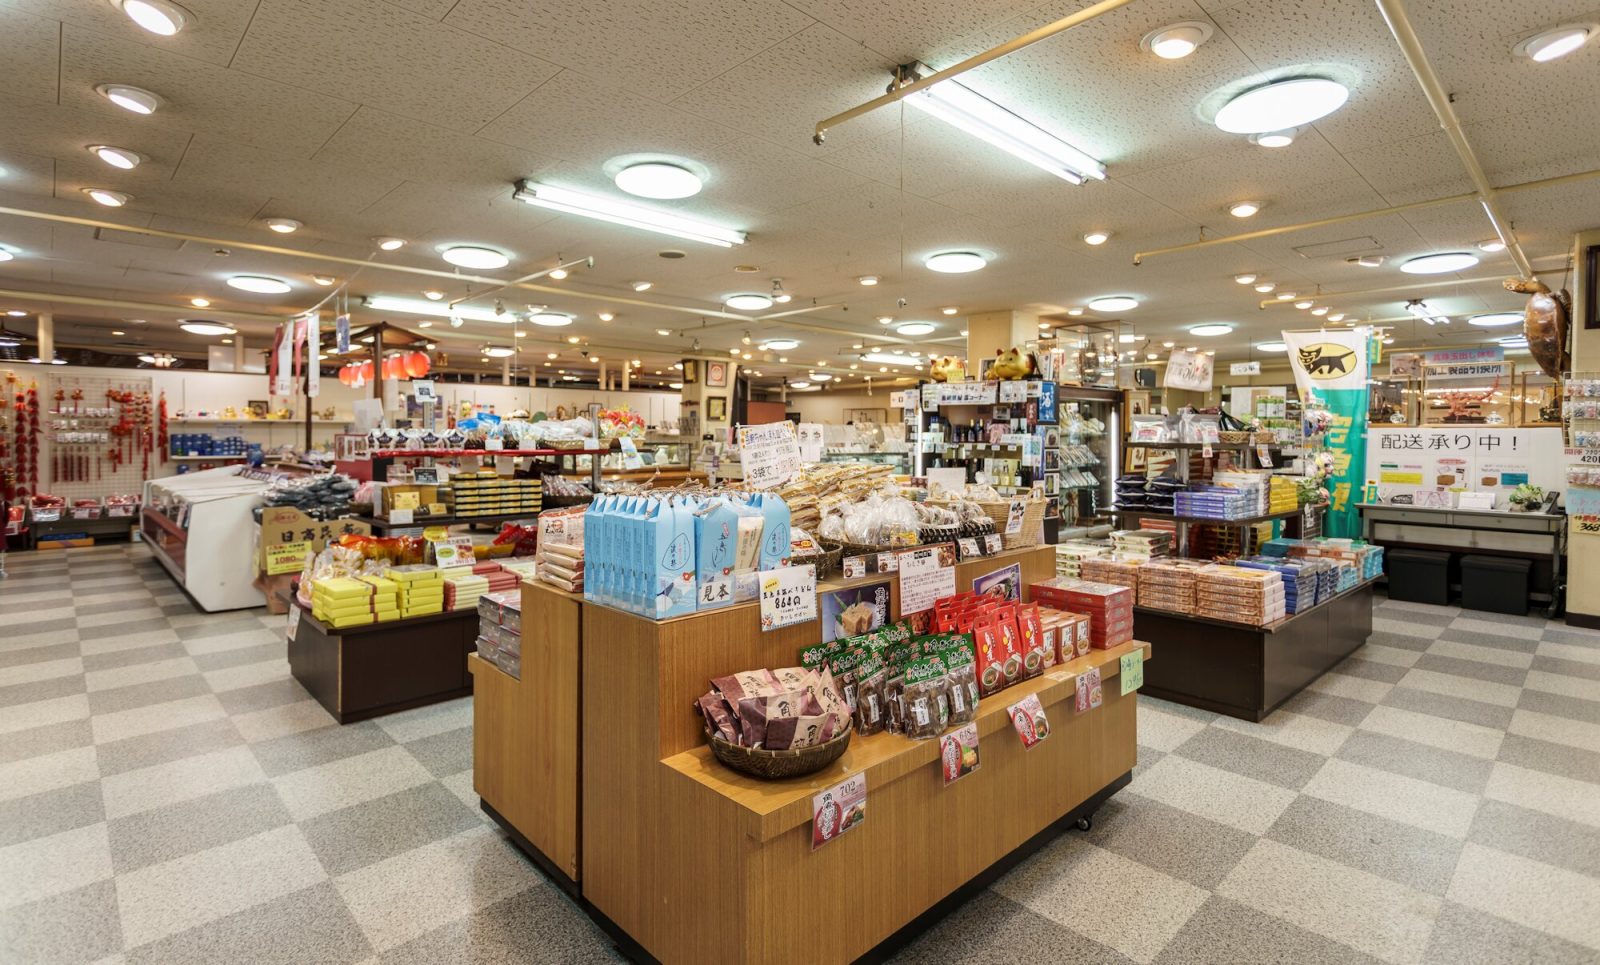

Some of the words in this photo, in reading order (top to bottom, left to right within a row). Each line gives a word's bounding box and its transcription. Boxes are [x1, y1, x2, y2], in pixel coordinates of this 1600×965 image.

[1581, 455, 1600, 463] 420
[702, 584, 729, 601] 見本
[775, 595, 801, 609] 864円
[840, 780, 857, 797] 702
